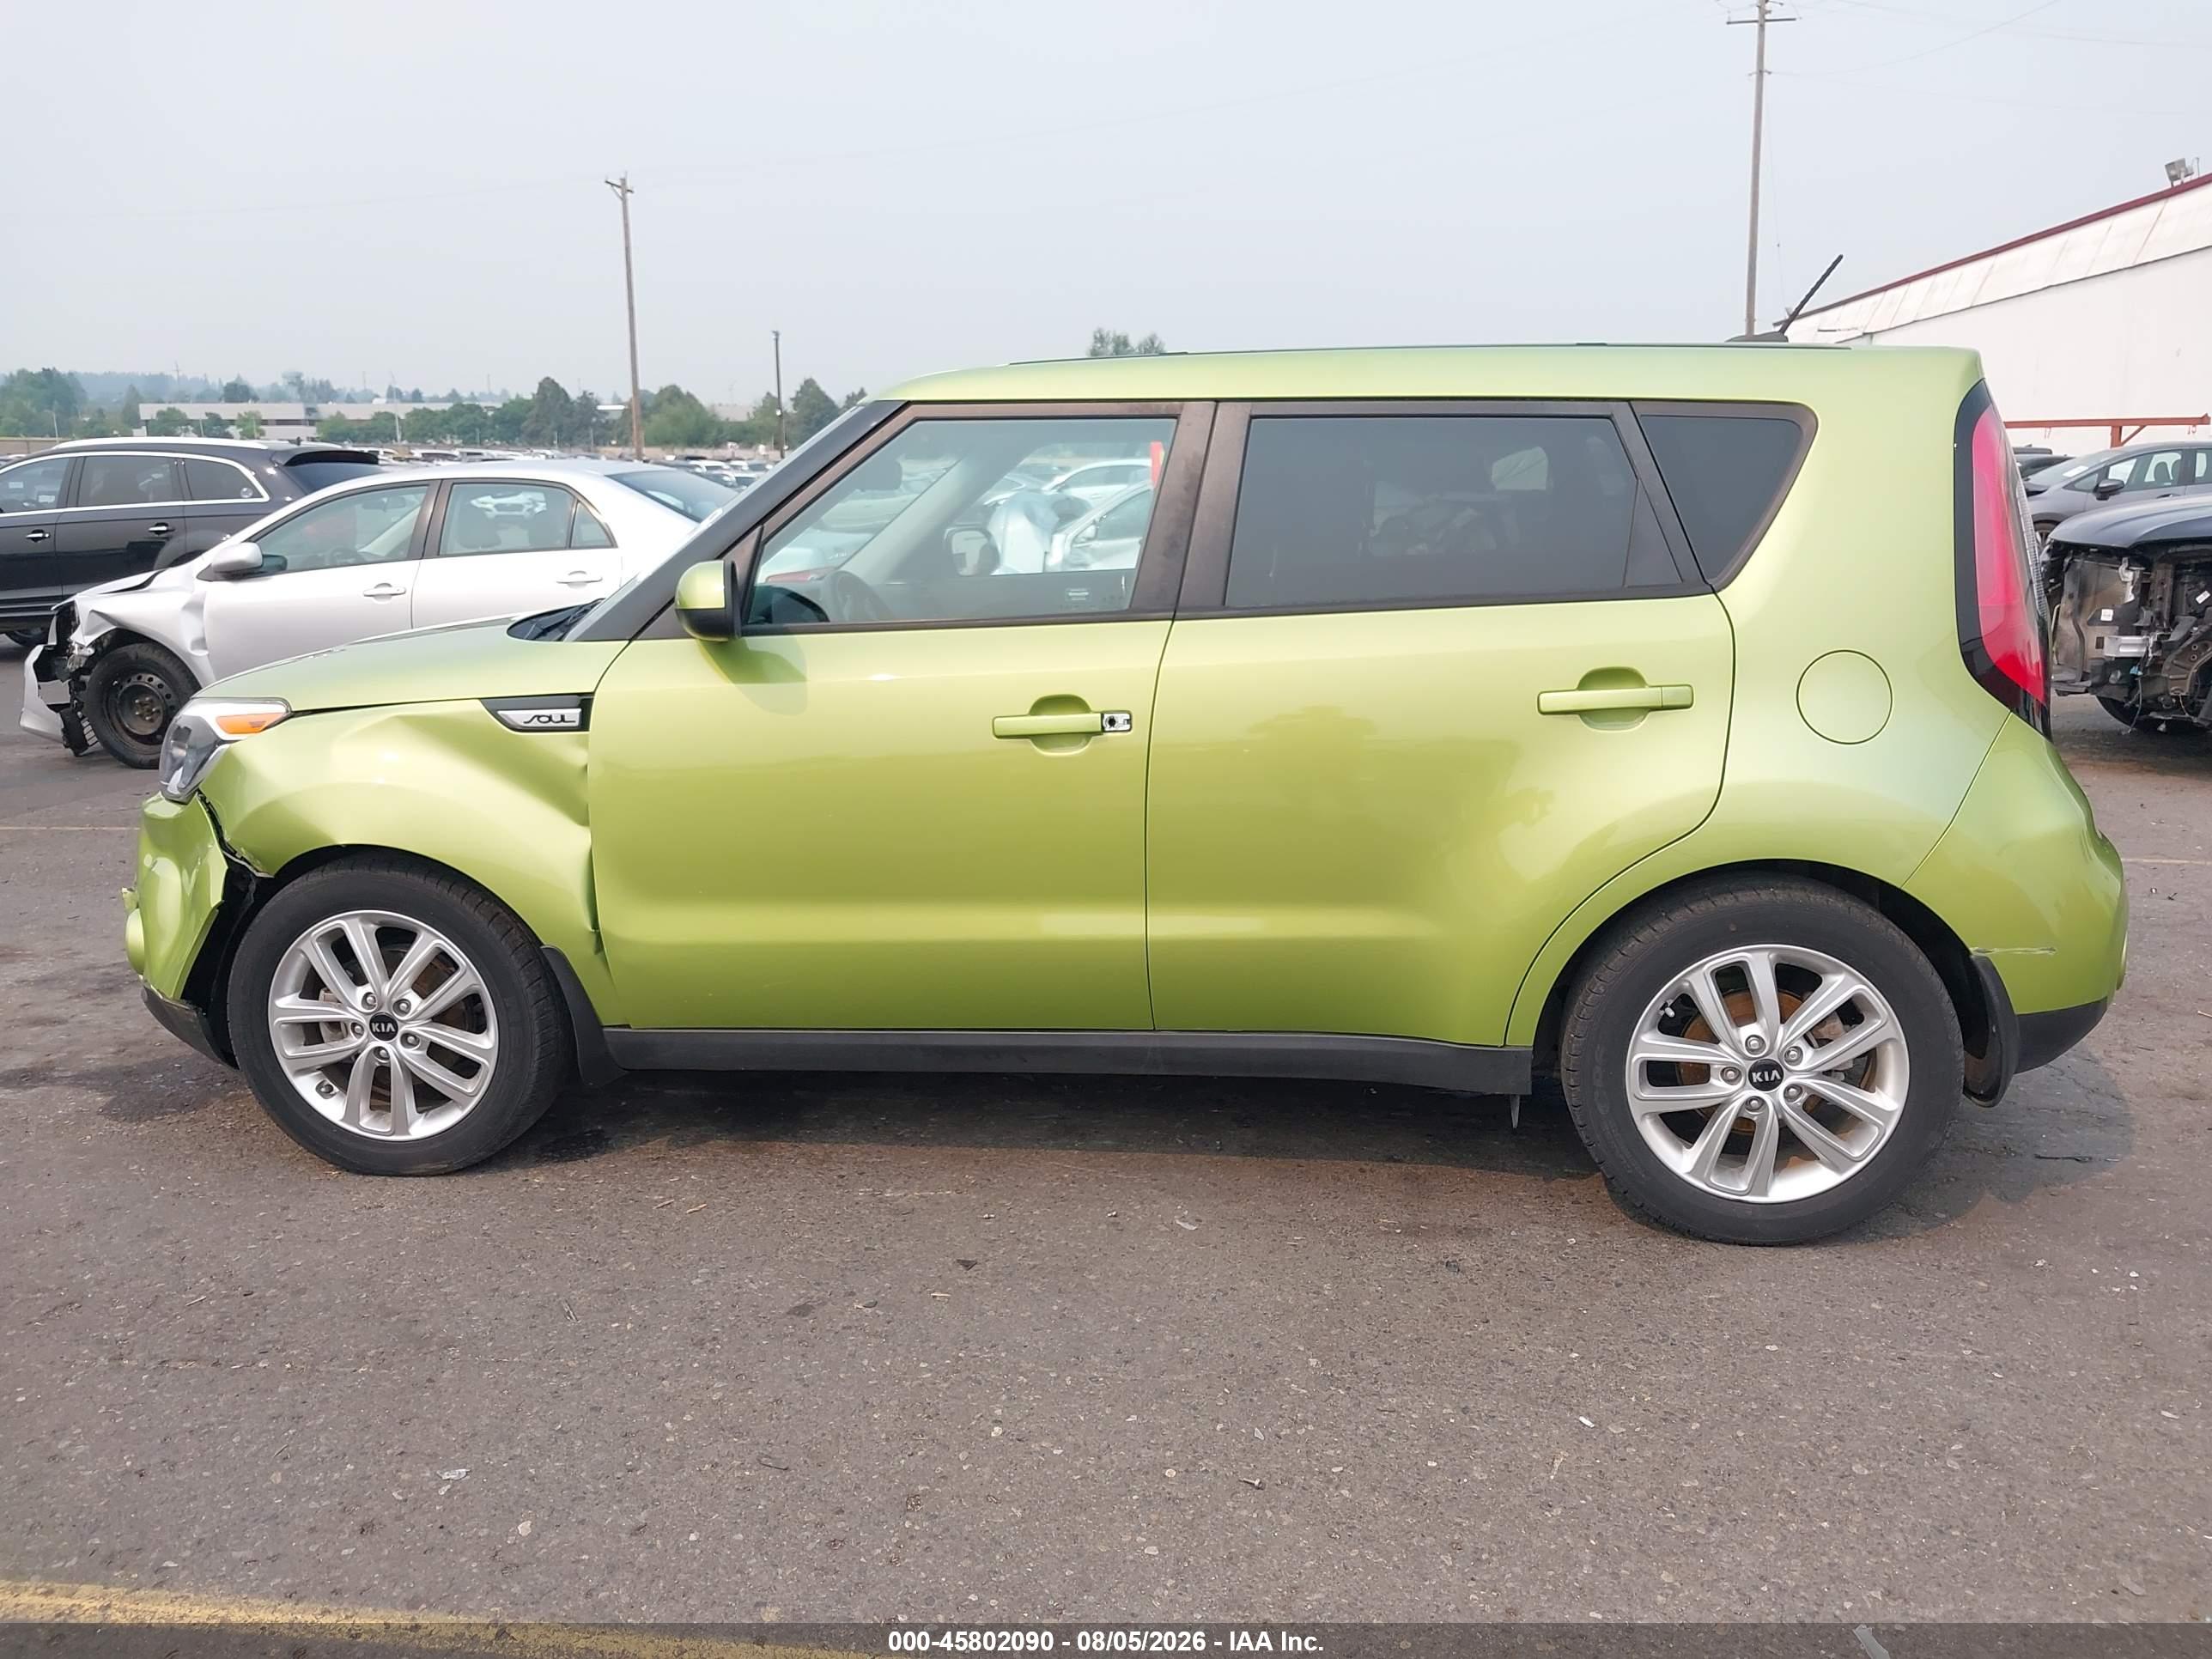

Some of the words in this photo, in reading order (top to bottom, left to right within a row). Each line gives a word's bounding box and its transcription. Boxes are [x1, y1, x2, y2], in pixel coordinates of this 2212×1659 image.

[523, 714, 576, 724] SOUL
[371, 1022, 396, 1032] KIA
[1752, 1069, 1782, 1083] KIA
